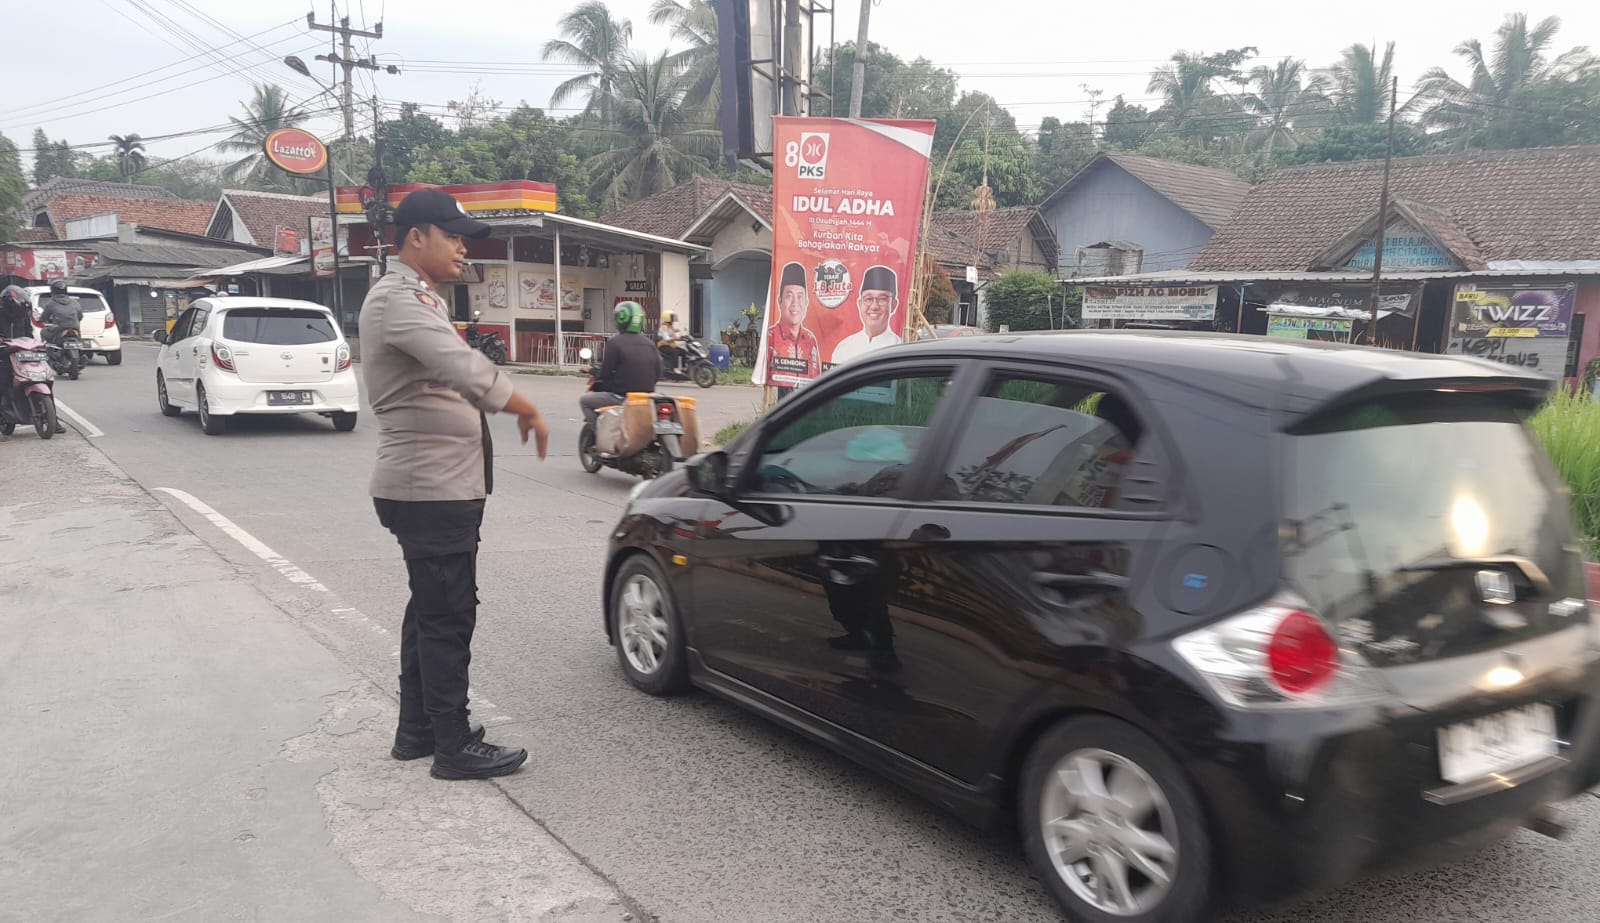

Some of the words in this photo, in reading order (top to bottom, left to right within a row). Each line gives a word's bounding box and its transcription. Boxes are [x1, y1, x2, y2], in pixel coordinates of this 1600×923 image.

[785, 141, 799, 167] 8
[799, 165, 824, 177] PKS
[814, 187, 840, 195] Selamat
[856, 189, 873, 198] Raya
[792, 196, 832, 213] IDUL
[837, 198, 895, 216] ADHA
[813, 230, 843, 240] Kurban
[845, 231, 863, 241] Kita
[798, 240, 846, 251] Bahagiakan
[848, 242, 880, 253] Rakyat
[829, 281, 853, 291] Juta
[1148, 287, 1164, 297] AC
[1168, 287, 1209, 297] MOBIL
[1307, 296, 1363, 306] MAGNUM
[1474, 305, 1552, 321] TWIZZ
[1462, 337, 1508, 355] KOPI
